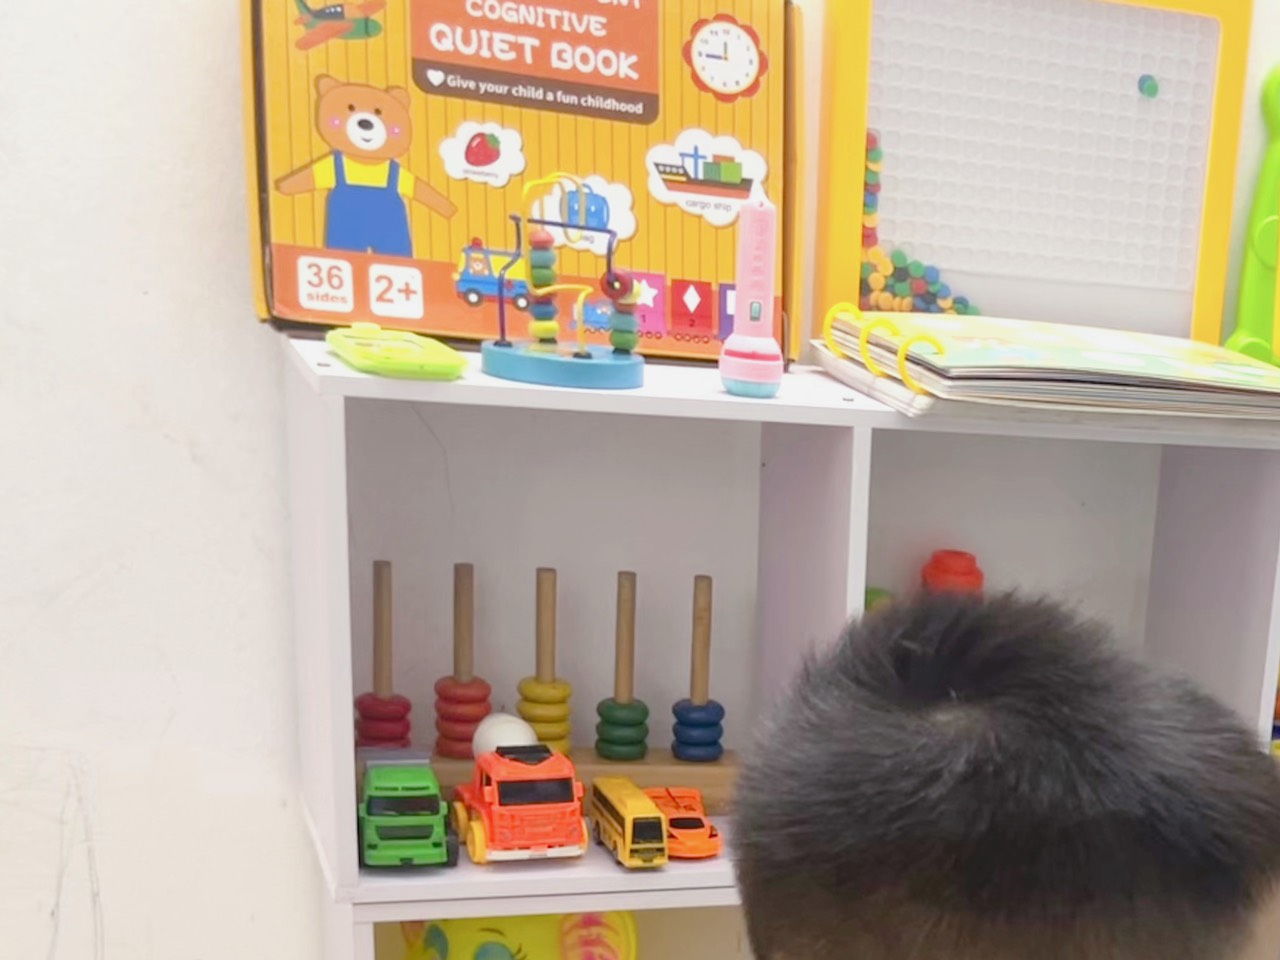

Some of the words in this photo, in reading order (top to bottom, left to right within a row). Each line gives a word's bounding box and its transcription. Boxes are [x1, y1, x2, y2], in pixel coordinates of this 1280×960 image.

[465, 0, 607, 36] COGNITIVE
[429, 23, 540, 64] QUIET
[551, 42, 639, 79] BOOK
[447, 74, 476, 90] Give
[478, 81, 509, 95] your
[511, 85, 543, 100] child
[546, 91, 555, 102] a
[556, 90, 578, 105] fun
[580, 95, 644, 114] childhood
[685, 199, 712, 210] cargo
[713, 202, 732, 212] ship
[306, 262, 344, 290] 36
[375, 274, 418, 304] 2+
[306, 292, 348, 304] sides
